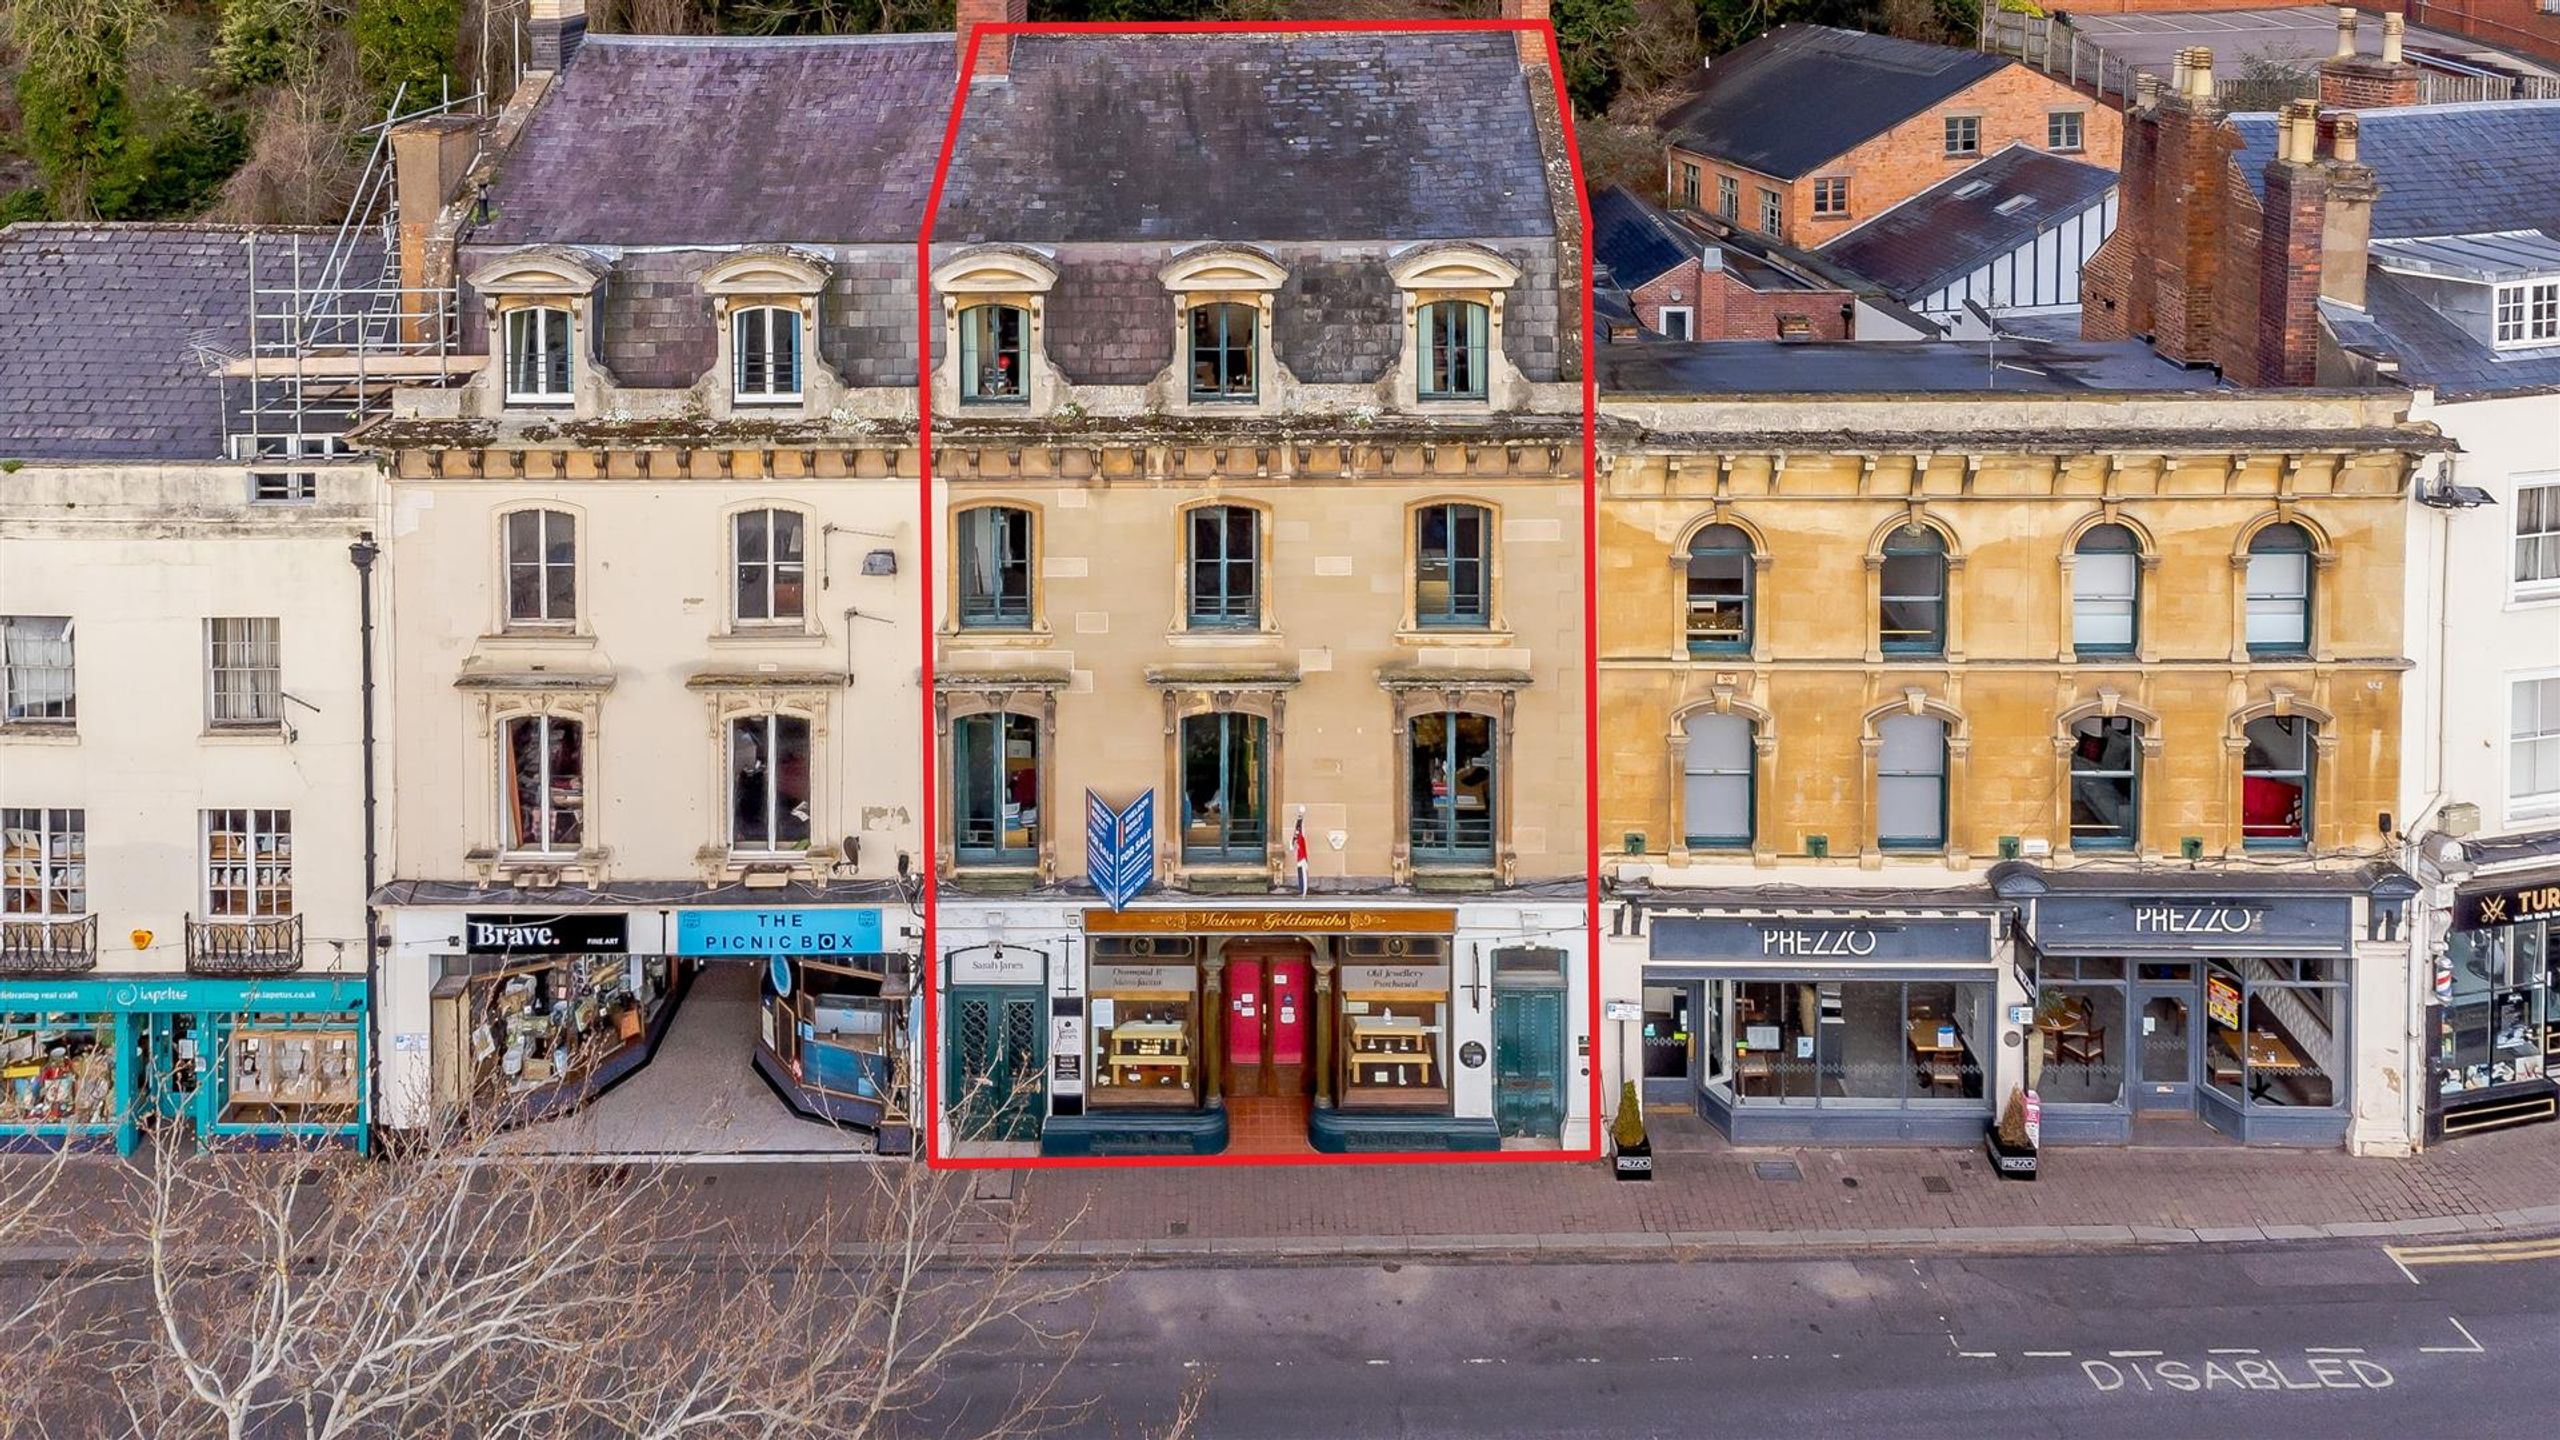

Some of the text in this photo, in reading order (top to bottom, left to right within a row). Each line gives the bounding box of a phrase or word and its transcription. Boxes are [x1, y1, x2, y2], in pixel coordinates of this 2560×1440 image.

[1120, 845, 1135, 865] FOR
[1135, 828, 1152, 851] SALE
[758, 914, 803, 928] THE
[1190, 911, 1347, 931] Malvern Goldsmiths
[2136, 908, 2251, 933] PREZZO
[476, 922, 561, 946] Brave.
[605, 937, 619, 945] ART
[706, 933, 853, 950] PICNIC BOX
[1763, 930, 1876, 955] PREZZO
[972, 960, 1024, 973] Sarah Janes
[1366, 968, 1423, 978] Old Jewellery
[41, 991, 57, 999] real
[58, 990, 79, 999] craft
[140, 986, 188, 1005] iapetus
[2081, 1360, 2395, 1392] DISABLED
